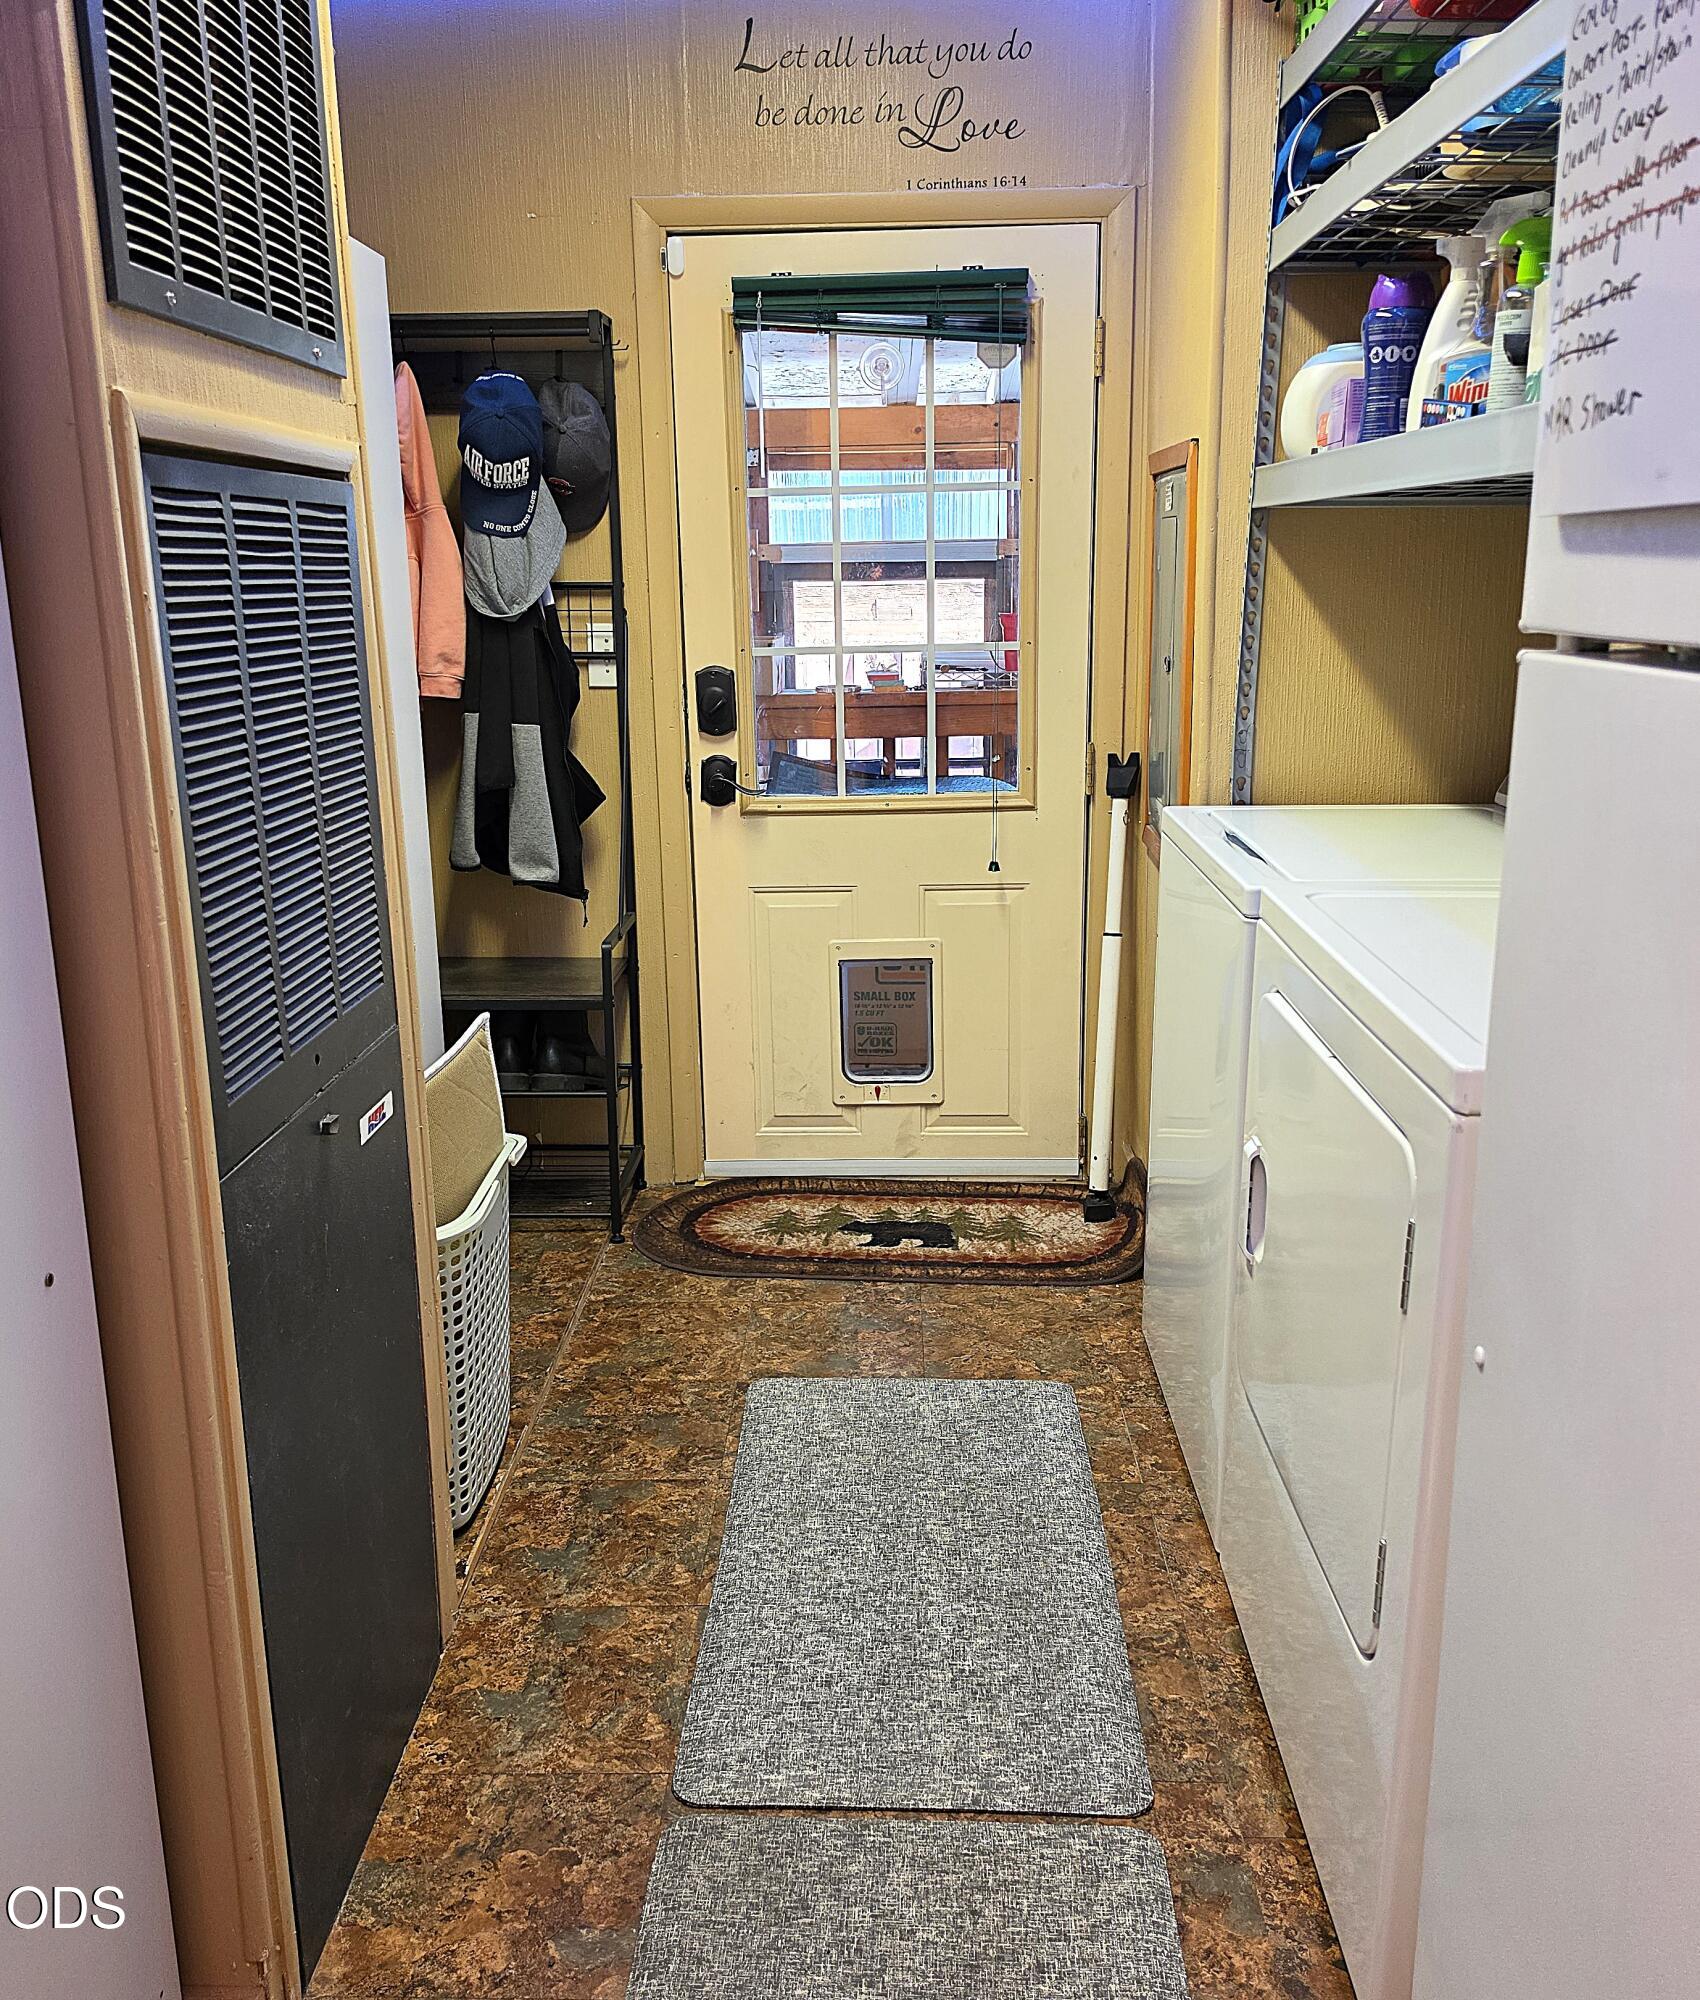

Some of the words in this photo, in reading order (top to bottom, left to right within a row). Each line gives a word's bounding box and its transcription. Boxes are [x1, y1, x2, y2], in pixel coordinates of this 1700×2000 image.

[734, 17, 808, 74] Let
[814, 36, 858, 68] all
[864, 34, 929, 68] that
[928, 41, 991, 79] you
[997, 28, 1033, 61] do
[755, 94, 787, 127] be
[794, 94, 865, 126] done
[875, 91, 908, 124] in
[898, 86, 1026, 152] Love
[906, 179, 912, 191] 1
[917, 177, 988, 191] Corinthians
[464, 443, 483, 478] AIR
[484, 456, 530, 484] FORCE
[493, 479, 528, 489] STATES
[482, 520, 495, 530] NO
[495, 524, 512, 533] ONE
[512, 513, 531, 532] COMES
[527, 489, 538, 514] CLOSE
[853, 991, 891, 1001] SMALL
[894, 991, 916, 1001] BOX
[870, 1037, 894, 1048] OK
